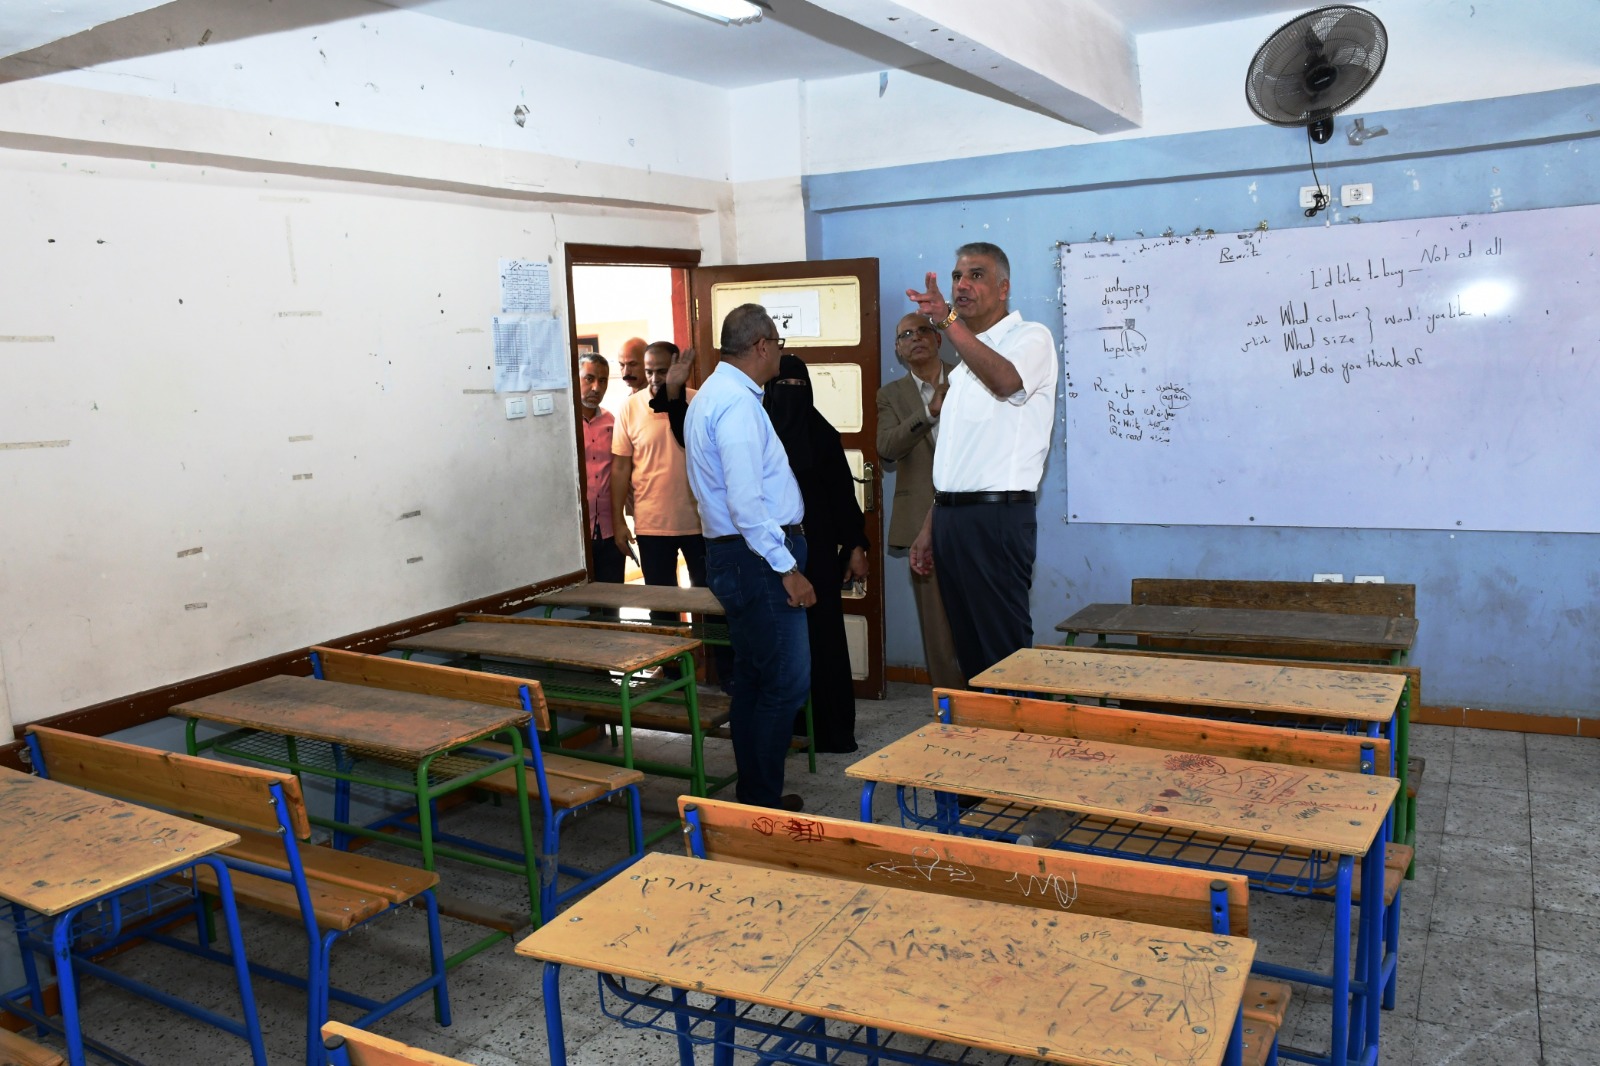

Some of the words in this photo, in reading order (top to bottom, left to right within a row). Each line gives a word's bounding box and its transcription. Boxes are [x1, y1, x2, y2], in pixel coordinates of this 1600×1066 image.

[1421, 245, 1449, 263] Not
[1486, 237, 1502, 255] all
[1382, 258, 1403, 287] buy
[1105, 277, 1150, 298] unhappy
[1102, 295, 1144, 310] disagree
[1280, 301, 1309, 326] What
[1317, 299, 1359, 322] colour
[1284, 327, 1315, 352] What
[1323, 335, 1355, 346] size
[1293, 357, 1315, 378] What
[1320, 358, 1334, 374] do
[1342, 362, 1361, 384] you
[1367, 347, 1402, 368] think
[1407, 348, 1423, 364] of
[1162, 394, 1189, 409] again
[1080, 930, 1112, 943] BTS
